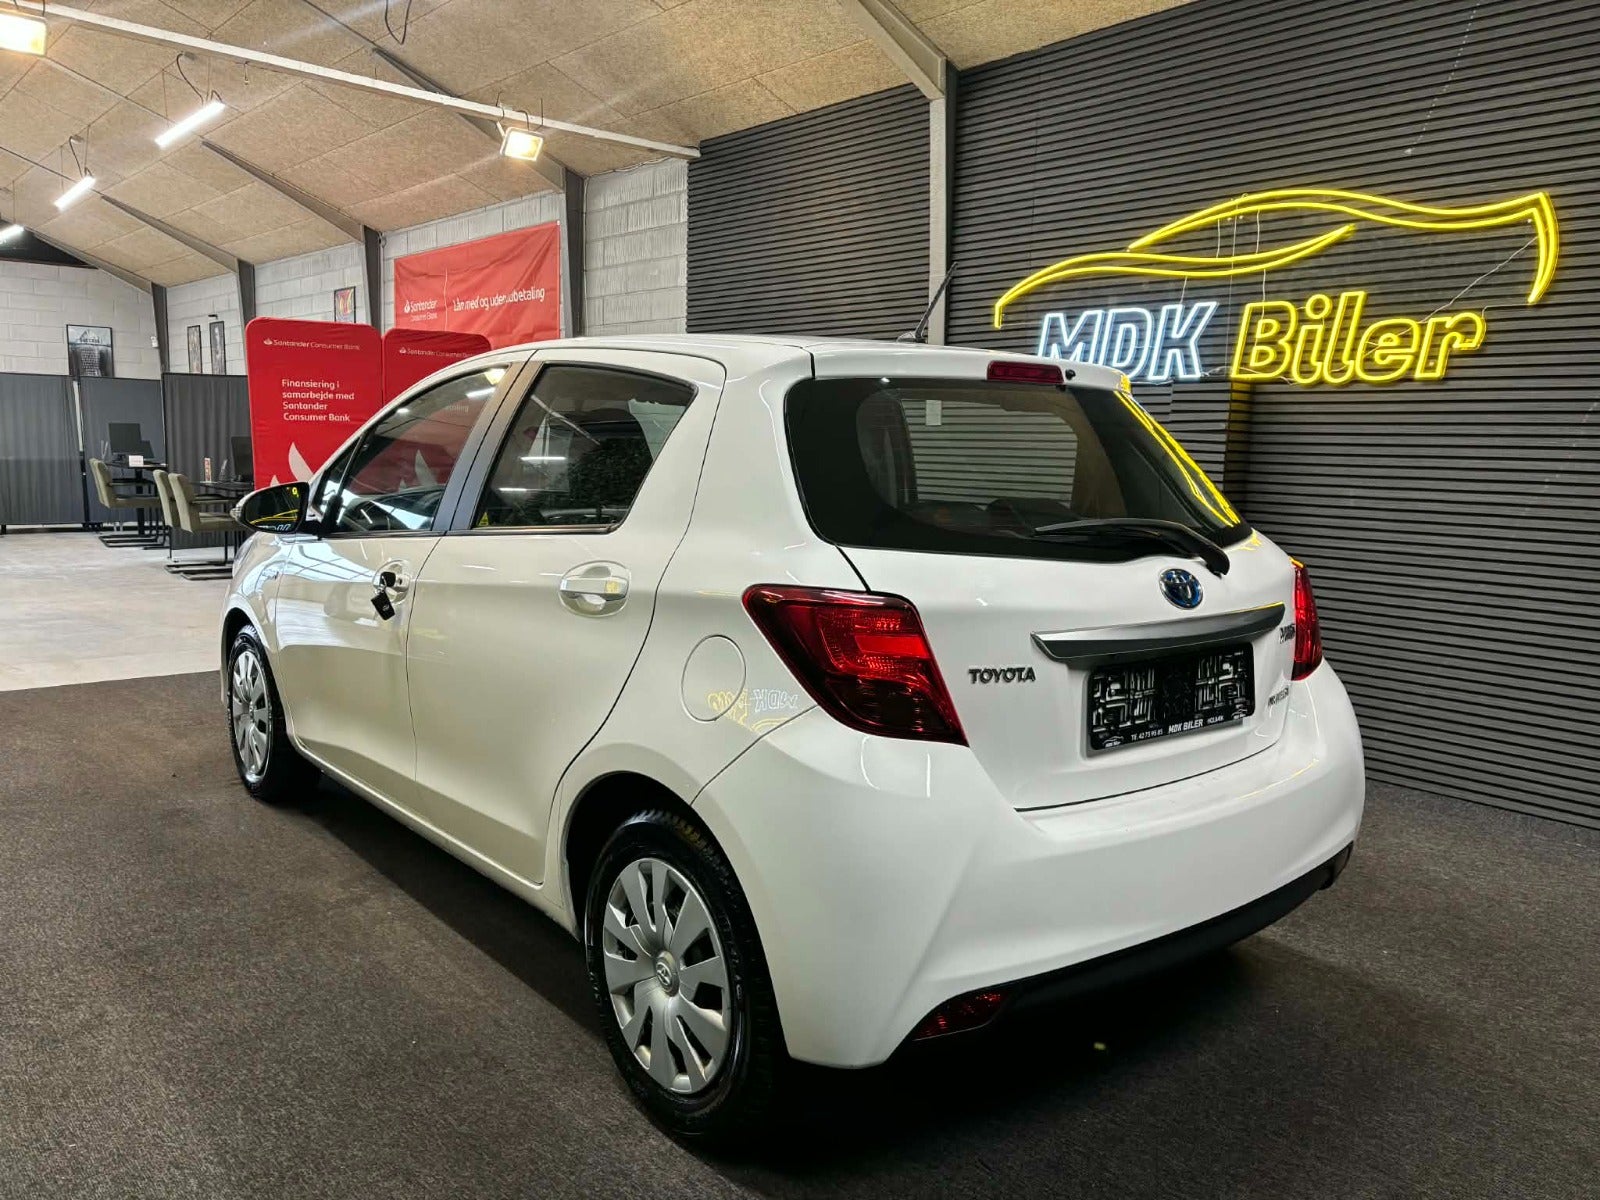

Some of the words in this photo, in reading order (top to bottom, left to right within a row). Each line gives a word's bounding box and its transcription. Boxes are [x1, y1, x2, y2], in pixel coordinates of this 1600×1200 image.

[410, 300, 438, 312] Santander
[465, 295, 479, 310] med
[480, 298, 489, 310] og
[490, 293, 506, 307] uden
[1036, 302, 1217, 381] MDK
[1231, 290, 1485, 385] Biler
[273, 340, 309, 348] Santander
[310, 341, 343, 350] Consumer
[407, 348, 436, 356] Santander
[282, 379, 335, 390] Finansiering
[282, 391, 334, 401] samarbejde
[335, 392, 355, 400] med
[283, 401, 328, 410] Santander
[283, 412, 327, 421] Consumer
[328, 413, 351, 422] Bank
[968, 667, 1036, 684] TOYOTA
[1168, 722, 1182, 734] MDK
[1183, 718, 1204, 731] BILER
